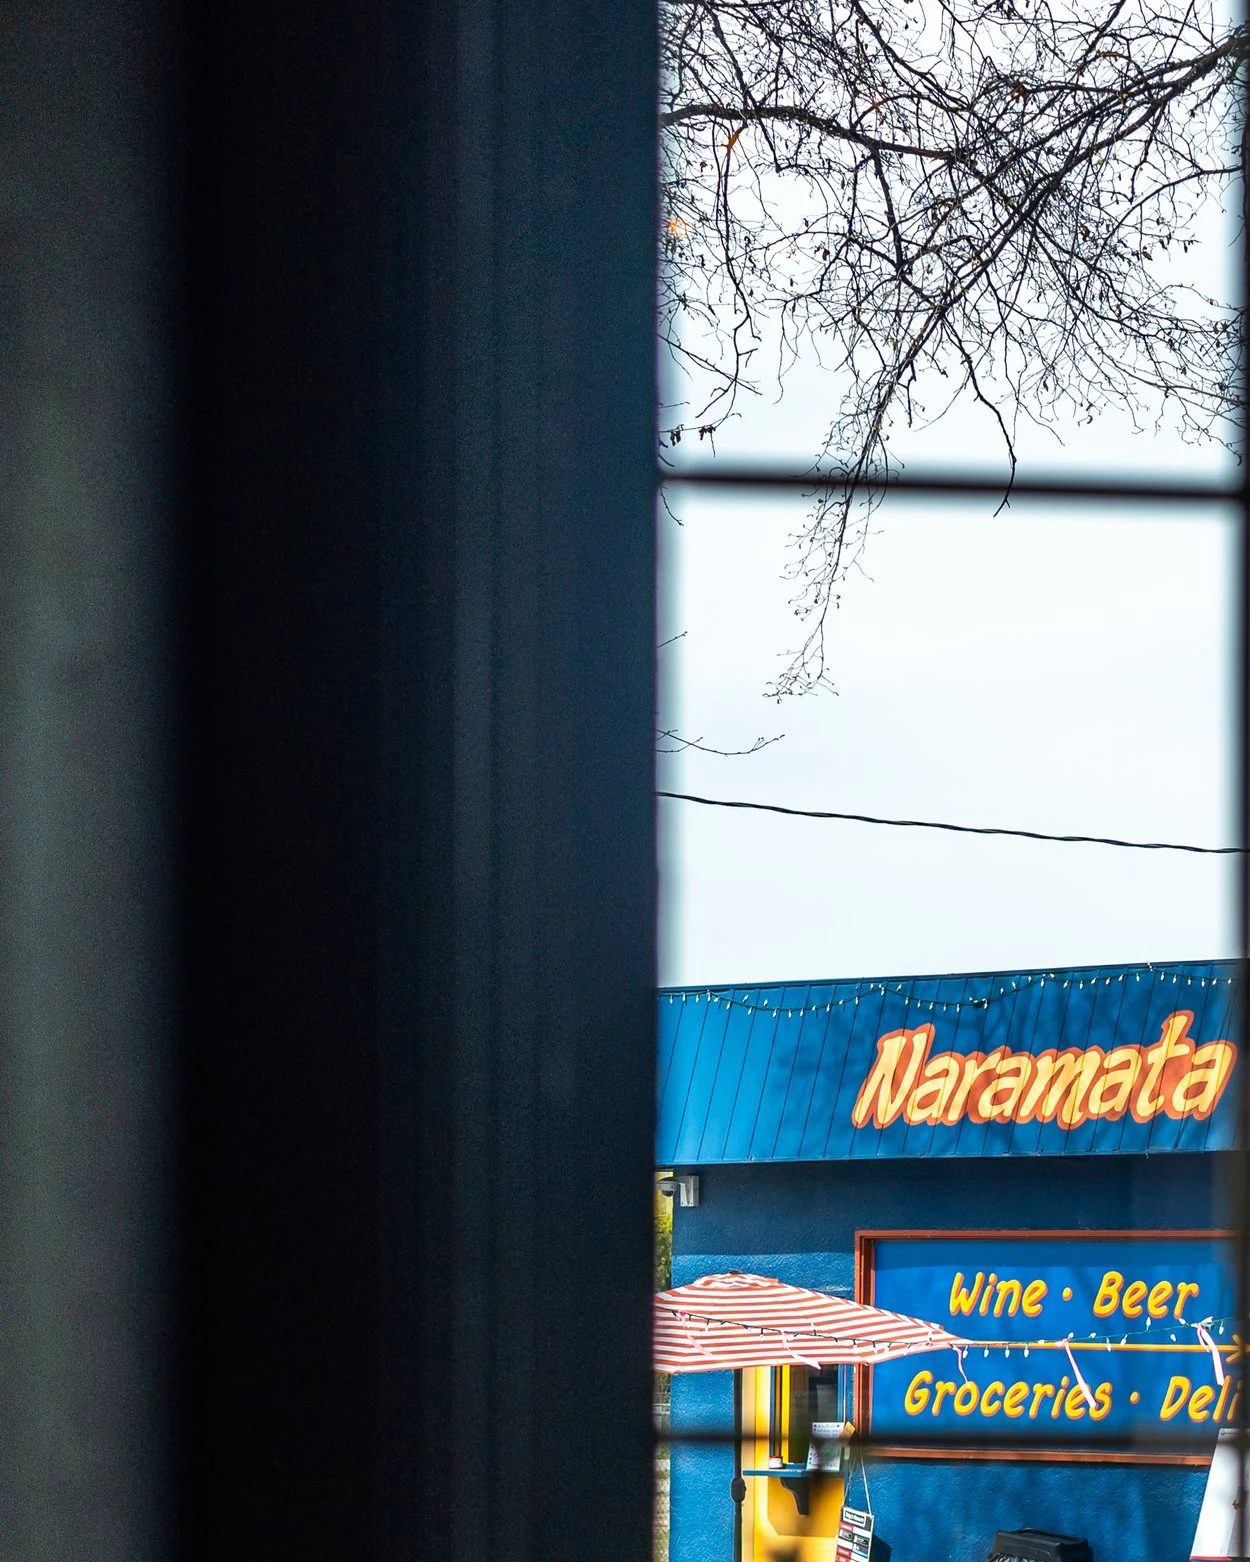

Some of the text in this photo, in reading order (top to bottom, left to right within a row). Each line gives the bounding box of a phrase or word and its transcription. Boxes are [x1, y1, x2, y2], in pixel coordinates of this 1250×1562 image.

[852, 1009, 1238, 1130] Naramata
[949, 1270, 1199, 1319] Wine Beer
[904, 1370, 1243, 1423] Groceries Deli
